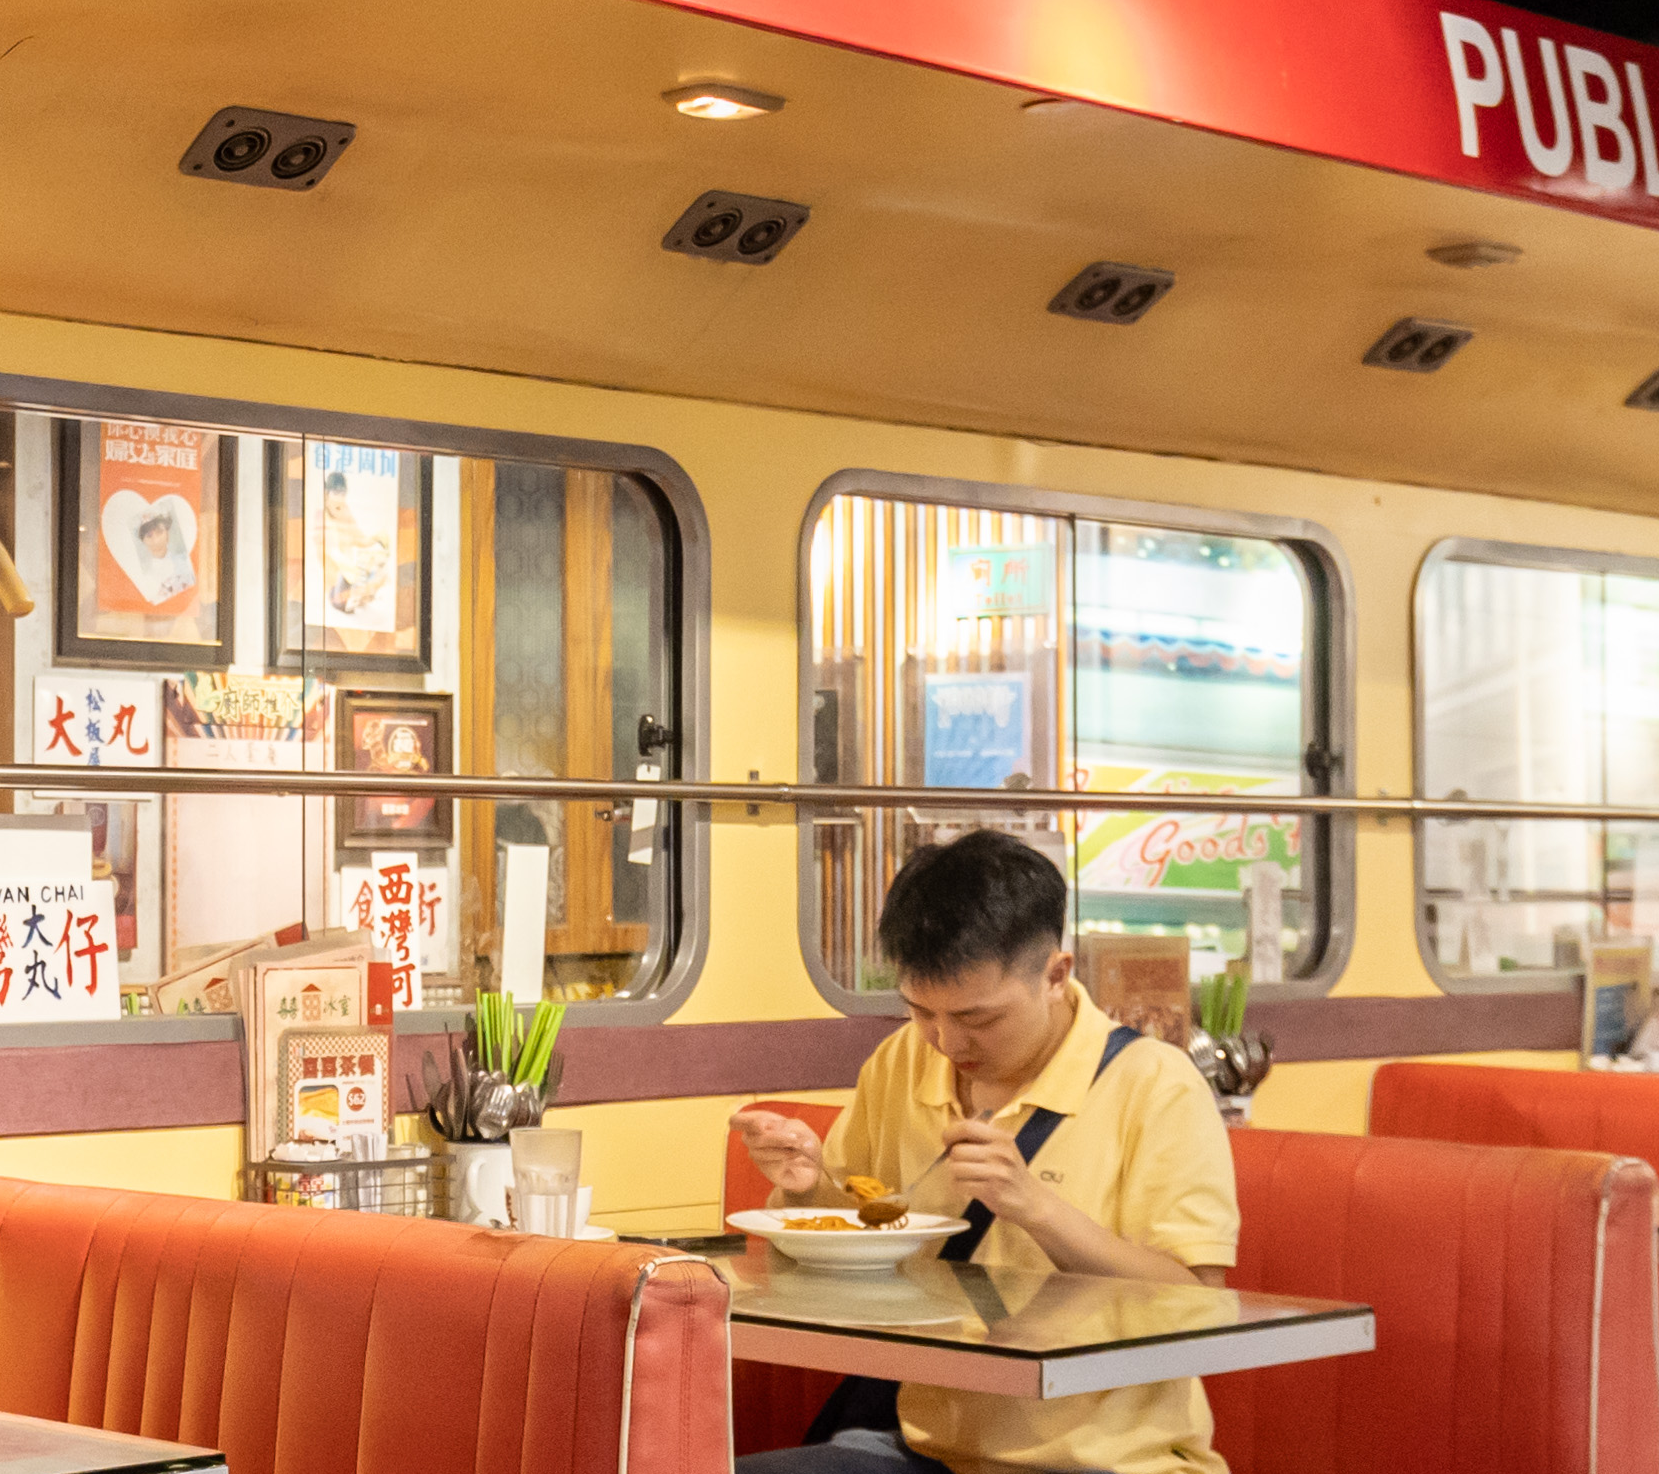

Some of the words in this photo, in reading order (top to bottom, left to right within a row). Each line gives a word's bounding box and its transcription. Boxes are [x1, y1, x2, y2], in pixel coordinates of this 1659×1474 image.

[40, 884, 85, 904] CHAI
[21, 904, 62, 1001] 大丸
[53, 908, 109, 998] 仔
